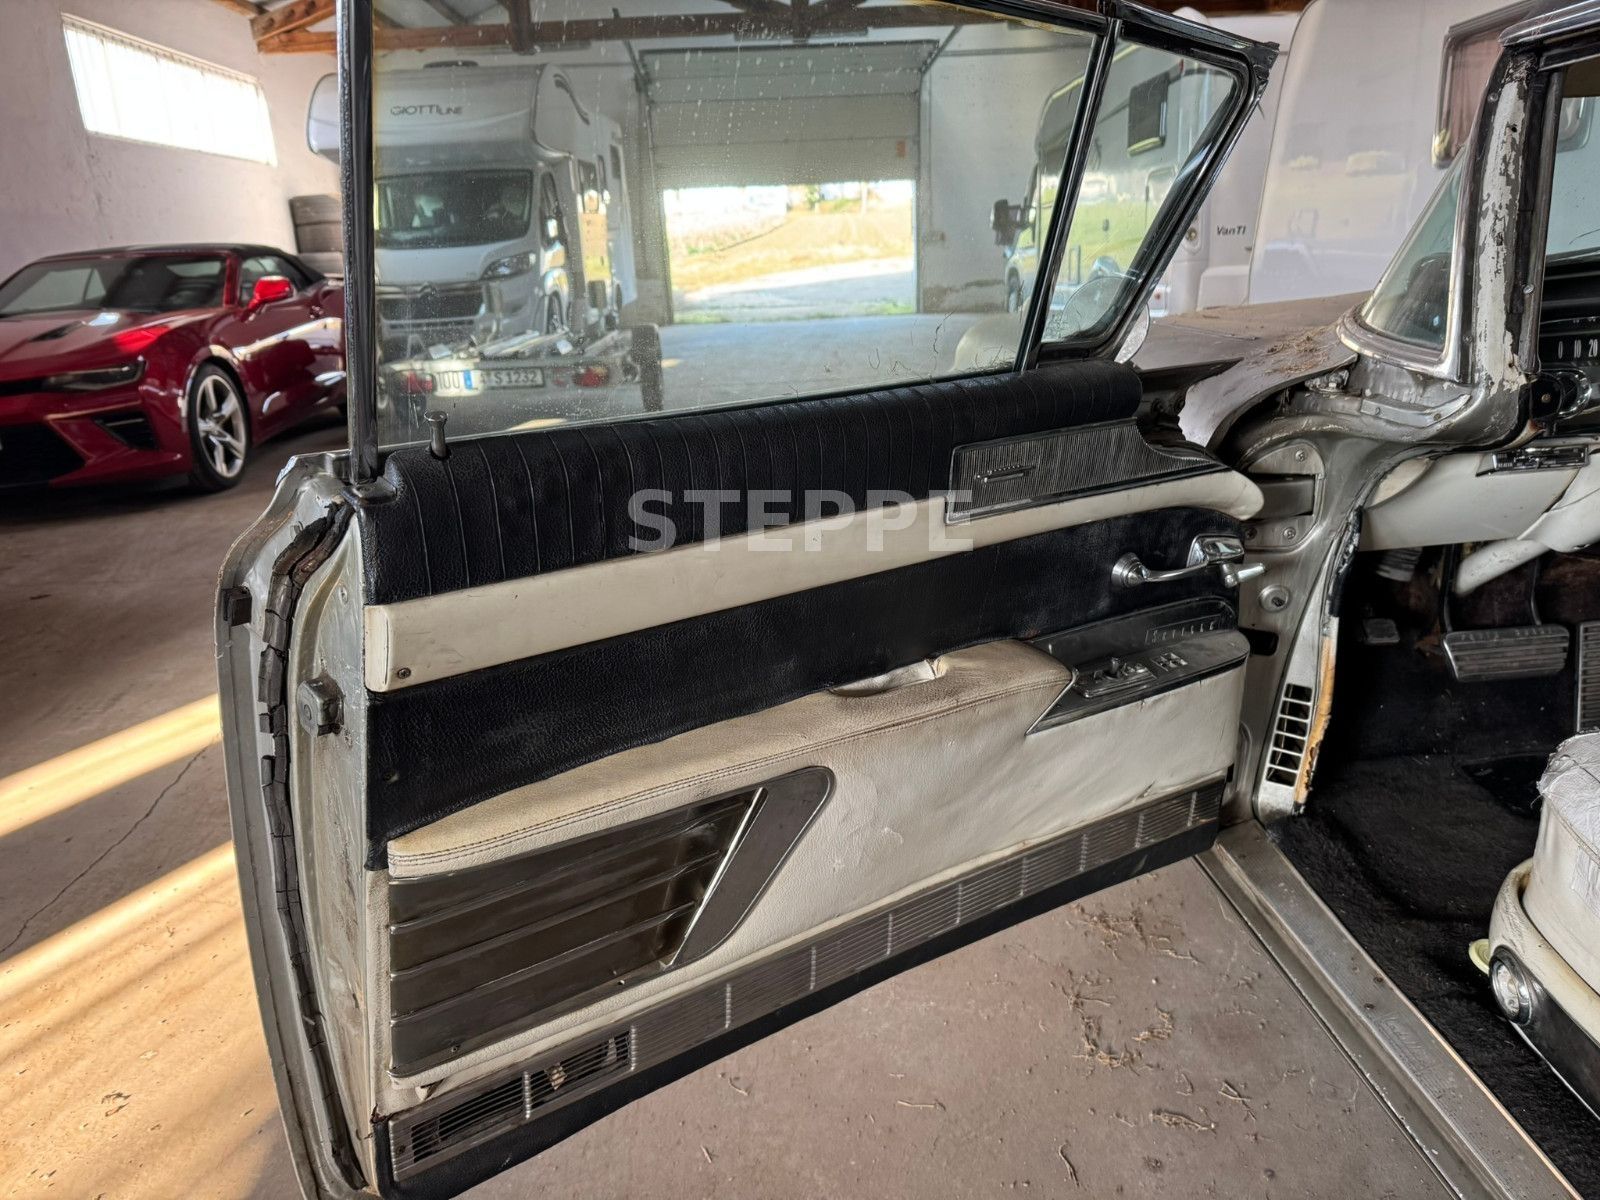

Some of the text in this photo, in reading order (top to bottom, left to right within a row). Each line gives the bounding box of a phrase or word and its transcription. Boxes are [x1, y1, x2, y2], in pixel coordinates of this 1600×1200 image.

[1558, 339, 1598, 359] 0 10 20
[506, 370, 537, 384] 1232
